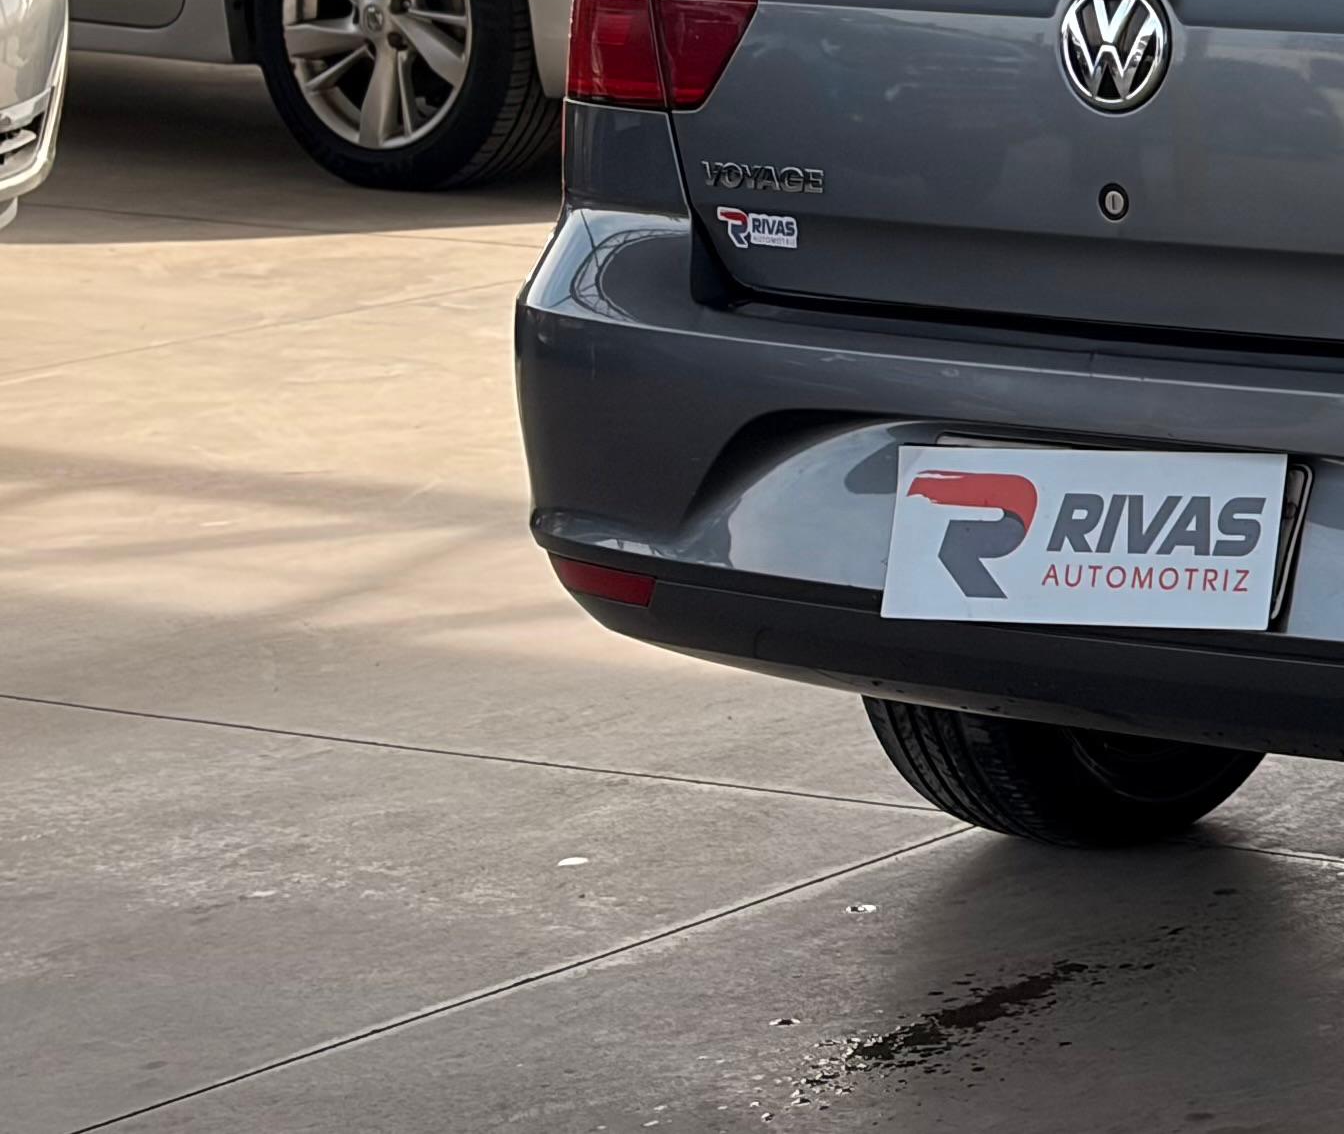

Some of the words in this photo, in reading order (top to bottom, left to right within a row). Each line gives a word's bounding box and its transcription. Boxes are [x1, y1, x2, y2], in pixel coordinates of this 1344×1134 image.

[701, 160, 824, 194] VOYAGE
[751, 216, 796, 237] RIVAS
[1046, 493, 1266, 557] RIVAS
[1041, 565, 1249, 592] AUTOMOTRIZ
